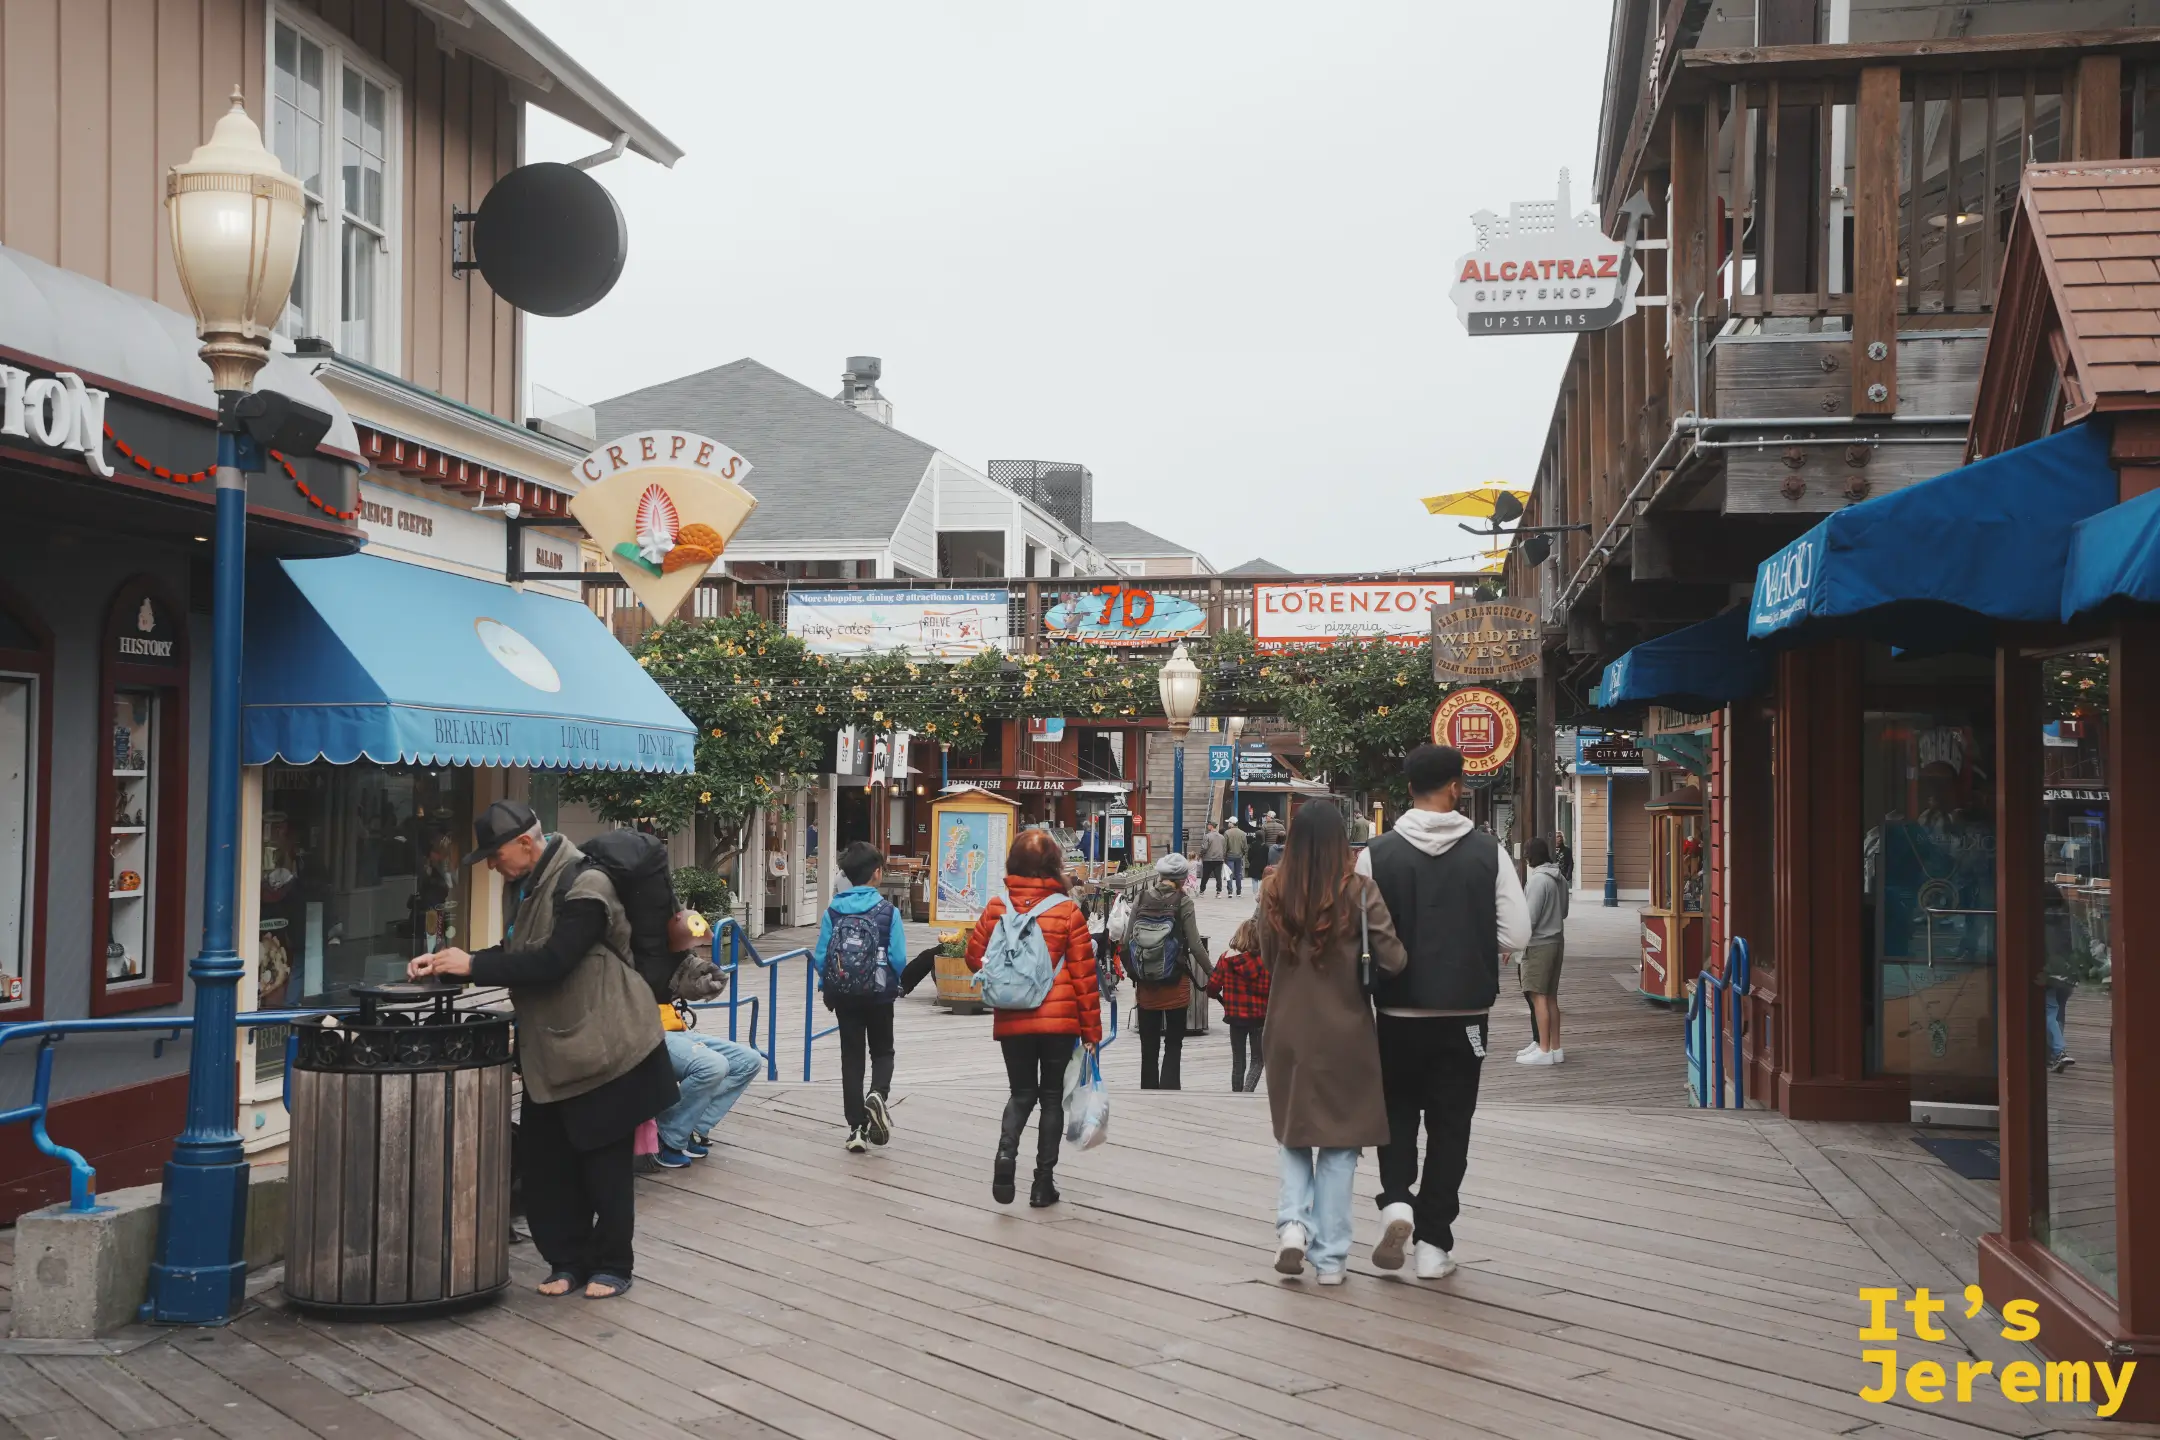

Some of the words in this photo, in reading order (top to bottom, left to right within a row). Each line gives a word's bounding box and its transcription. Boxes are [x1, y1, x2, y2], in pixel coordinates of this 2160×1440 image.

[1459, 254, 1619, 283] ALCATRAZ
[1474, 288, 1527, 302] GIFT
[1537, 286, 1598, 300] SHOP
[1484, 314, 1587, 328] UPSTAIRS
[0, 364, 114, 478] ION
[582, 435, 743, 481] CREPES
[397, 509, 433, 537] CREPES
[535, 547, 564, 571] SALADS
[799, 593, 822, 603] More
[823, 593, 865, 604] shopping,
[866, 593, 894, 604] dining
[895, 593, 905, 602] &
[906, 592, 952, 602] attractions
[953, 594, 965, 602] on
[966, 592, 989, 602] Level
[990, 593, 996, 602] 2
[1092, 584, 1155, 628] 7D
[1265, 587, 1438, 613] LORENZO'S
[923, 616, 951, 628] SOLVE
[1438, 612, 1459, 628] SAN
[1464, 606, 1533, 623] FRANCISCO'S
[931, 628, 944, 639] IT!
[1046, 628, 1212, 643] experience
[1324, 621, 1382, 636] pizzeria
[1436, 627, 1539, 647] WILDER
[119, 637, 173, 657] HISTORY
[1450, 644, 1521, 660] WEST
[1438, 659, 1460, 673] URBAN
[1463, 666, 1494, 675] WESTERN
[1498, 653, 1538, 673] OUTFITTERS
[1441, 692, 1480, 718] CABLE
[1484, 695, 1508, 717] CAR
[434, 718, 512, 746] BREAKFAST
[560, 725, 600, 751] LUNCH
[638, 733, 674, 757] DINNER
[874, 752, 886, 772] USA
[1465, 754, 1499, 769] ORE
[1596, 750, 1618, 758] CITY
[1621, 750, 1644, 758] WEA
[1210, 758, 1231, 773] 39
[1277, 771, 1289, 779] hut
[978, 780, 1002, 789] FISH
[1016, 780, 1042, 790] FULL
[1043, 781, 1065, 790] BAR
